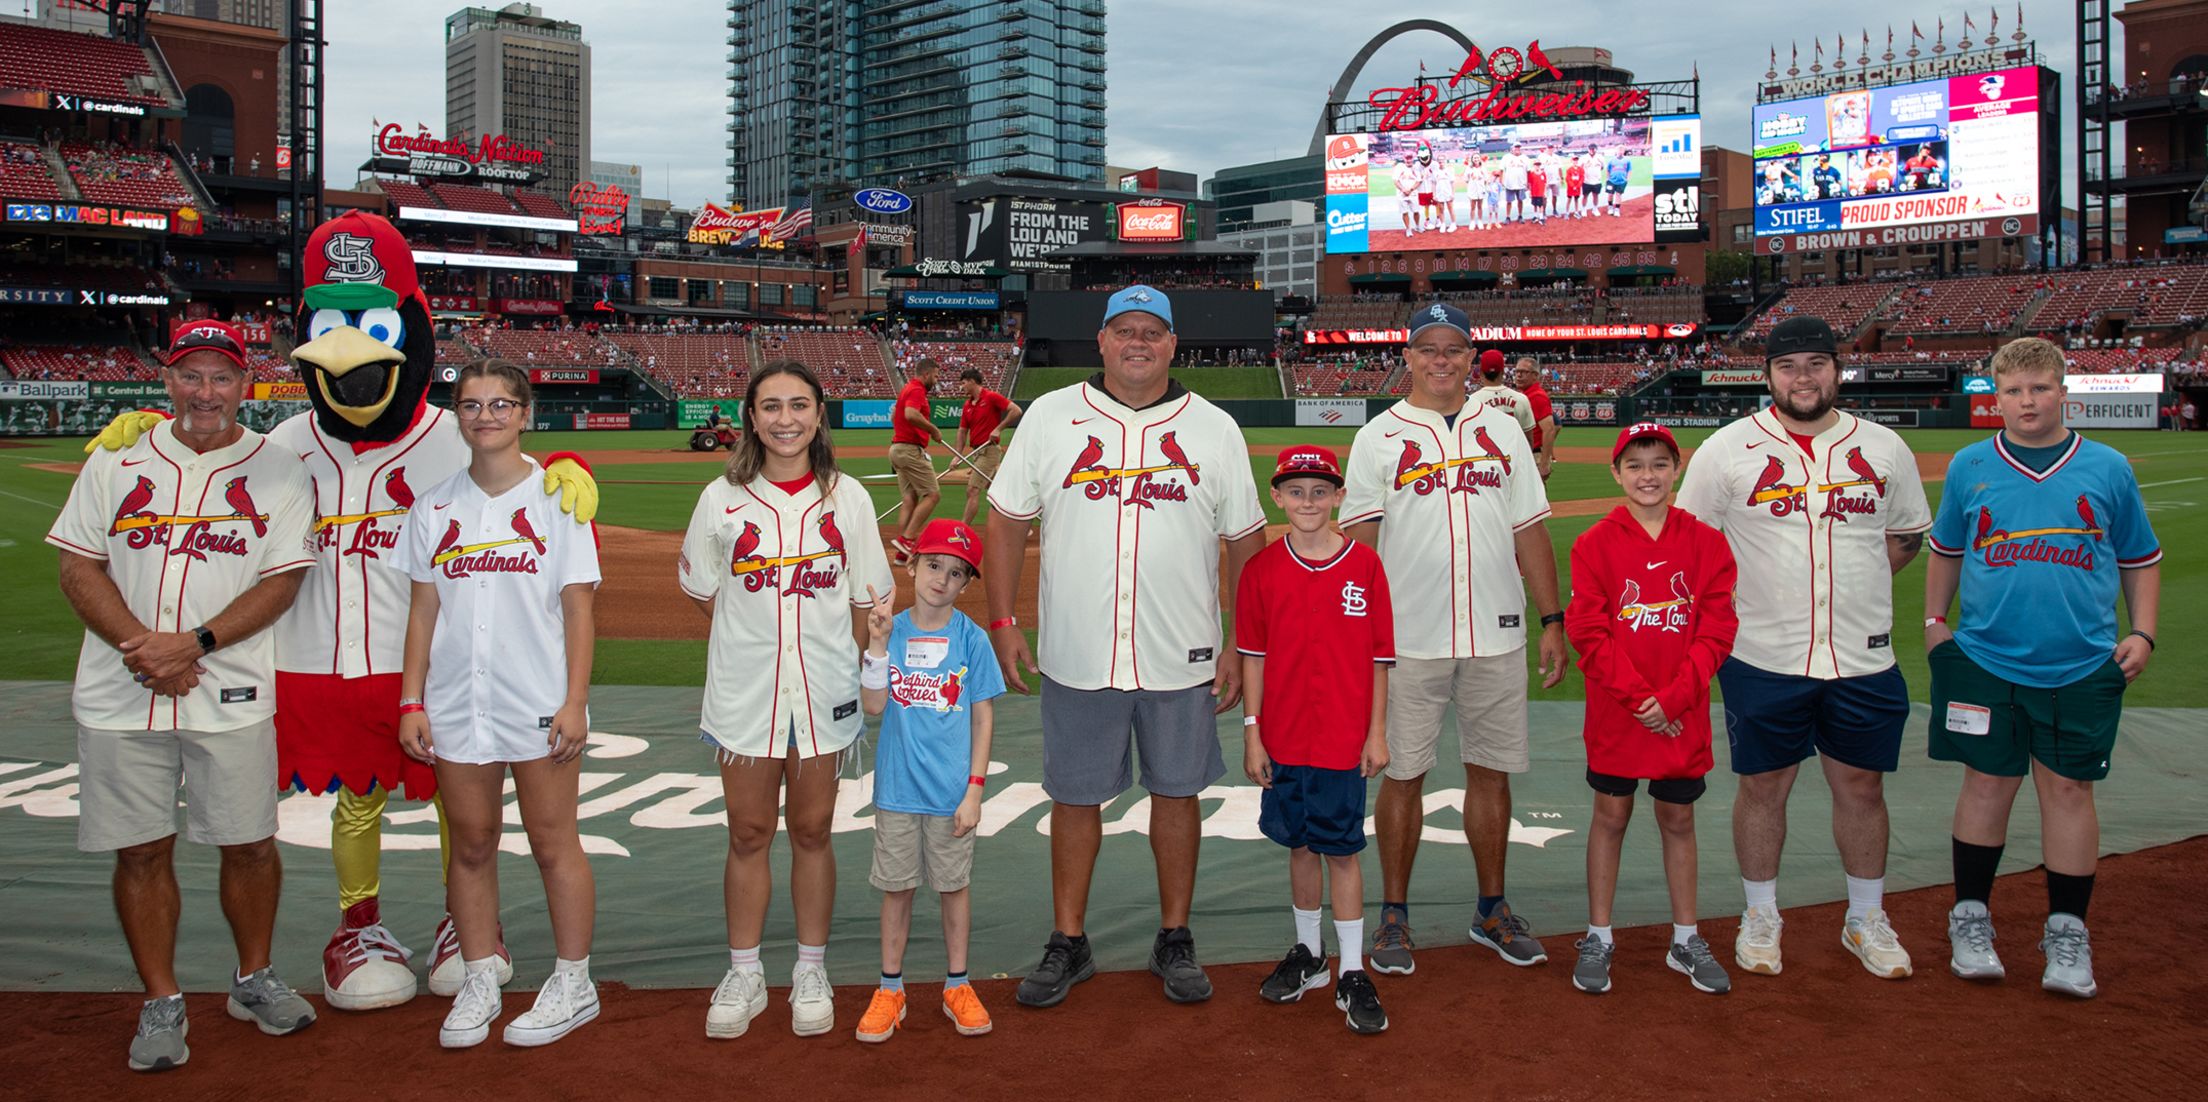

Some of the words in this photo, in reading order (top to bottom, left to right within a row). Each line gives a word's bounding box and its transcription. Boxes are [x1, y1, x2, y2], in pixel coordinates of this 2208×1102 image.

[1781, 71, 1863, 97] WORLD
[1866, 52, 2007, 84] CHAMPIONS
[83, 101, 144, 116] @cardinals
[1369, 84, 1650, 131] Budweiser
[1973, 101, 2011, 113] AVERAGE
[378, 123, 468, 157] Cardinals
[468, 133, 543, 164] Nation
[409, 157, 462, 173] HOFFMANN
[478, 166, 530, 180] ROOFTOP
[867, 191, 901, 209] Ford
[1024, 202, 1056, 212] PHORM
[1655, 186, 1698, 213] stl
[1840, 200, 1891, 224] PROUD
[1894, 195, 1967, 220] SPONSOR
[8, 205, 51, 221] BIG
[55, 207, 108, 224] MAC
[111, 208, 168, 231] LAND
[689, 206, 776, 229] Budwese
[1010, 211, 1054, 228] FROM
[1059, 215, 1089, 231] THE
[1125, 213, 1175, 231] Coca-Cola
[1656, 213, 1698, 223] TODAY
[1770, 208, 1825, 227] STIFEL
[580, 216, 622, 235] Live!
[859, 222, 912, 237] Community
[688, 229, 732, 245] BREW
[1010, 228, 1041, 242] LOU
[1044, 229, 1078, 245] AND
[1796, 231, 1860, 251] BROWN
[1866, 233, 1877, 245] &
[1883, 220, 1985, 243] CROUPPEN
[1414, 259, 1425, 272] 9
[1432, 258, 1447, 272] 10
[1454, 257, 1470, 271] 14
[1477, 256, 1493, 270] 17
[1500, 255, 1519, 270] 20
[1529, 256, 1548, 269] 23
[1555, 255, 1575, 268] 24
[1583, 253, 1602, 267] 42
[1611, 253, 1630, 266] 45
[1637, 252, 1656, 265] 85
[0, 291, 66, 302] RSITY
[107, 295, 169, 305] @cardinals
[907, 295, 933, 304] SCOTT
[936, 295, 965, 305] CREDIT
[968, 296, 995, 305] UNION
[243, 330, 266, 341] 156
[1348, 331, 1389, 342] WELCOME
[1391, 331, 1402, 341] TO
[1471, 327, 1522, 340] ADIUM
[1526, 328, 1545, 337] HOME
[1547, 328, 1555, 337] OF
[1557, 327, 1574, 337] YOUR
[1576, 327, 1586, 336] ST.
[1587, 327, 1608, 336] LOUIS
[1609, 326, 1647, 336] CARDINALS
[553, 372, 587, 380] PURINA
[1706, 372, 1766, 383] Schnucks
[1875, 371, 1895, 380] Mercy
[2079, 376, 2139, 385] Schnucks
[20, 382, 87, 399] Ballpark
[107, 387, 143, 396] Central
[271, 386, 307, 394] DOBB
[1485, 396, 1516, 409] ERMÍN
[1574, 408, 1586, 417] 66
[1598, 408, 1610, 417] 66
[2066, 401, 2151, 420] PERFICIENT
[1655, 419, 1680, 427] BUSCH
[1682, 418, 1720, 426] STADIUM
[1413, 463, 1449, 496] St.
[1450, 461, 1502, 495] Louis
[1084, 465, 1120, 501] St.
[1124, 471, 1188, 510] Louis
[1770, 484, 1808, 517] St.
[1819, 486, 1877, 523] Louis
[127, 511, 170, 549] St.
[170, 520, 248, 563] Louis
[344, 517, 400, 559] Loui
[1984, 529, 2095, 572] Cardinals
[441, 543, 539, 579] Cardinals
[744, 555, 781, 592] St.
[782, 559, 838, 599] Louis
[1627, 605, 1662, 633] The
[1665, 604, 1688, 633] Lou
[1528, 811, 1561, 819] TM
